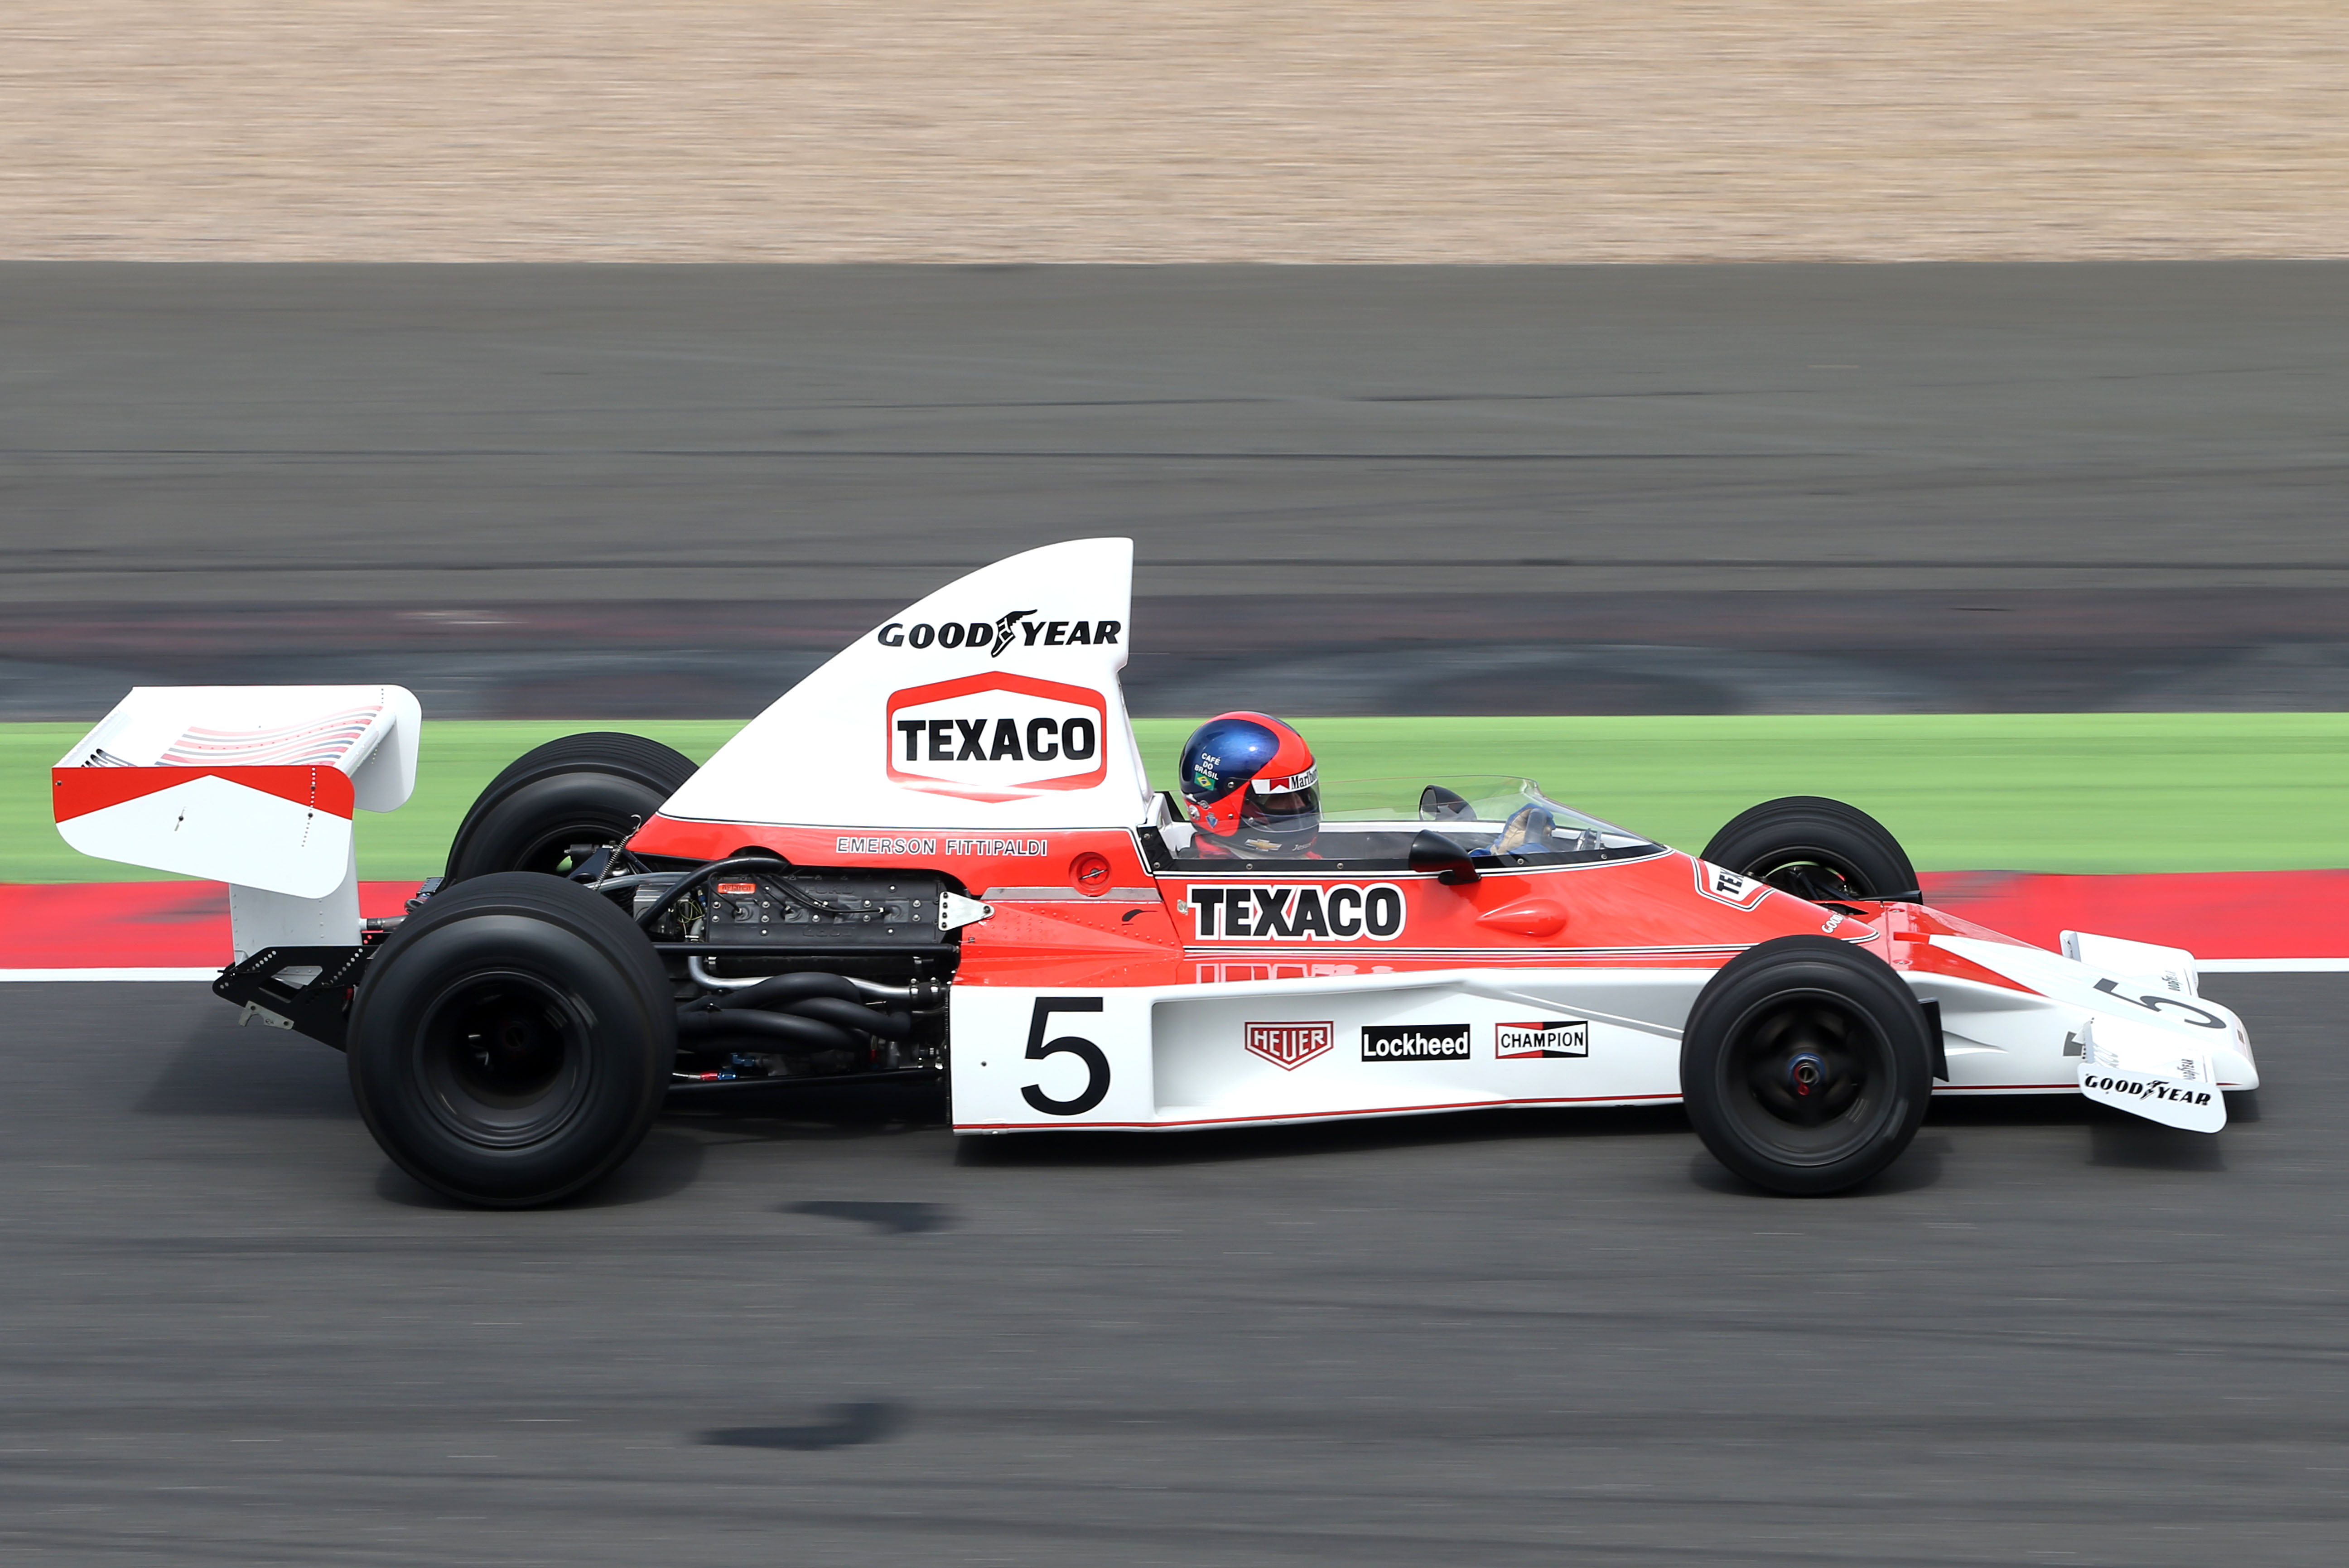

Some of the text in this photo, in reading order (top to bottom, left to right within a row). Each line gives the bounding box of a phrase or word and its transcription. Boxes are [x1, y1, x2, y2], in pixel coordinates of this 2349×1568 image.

[897, 717, 1095, 761] TEXACO
[1194, 764, 1219, 780] BRASIL
[1201, 753, 1220, 766] CAFÉ
[1203, 761, 1213, 770] DO
[835, 836, 1048, 857] EMERSON FITTIPALDI
[1191, 887, 1402, 937] TEXACO
[2092, 977, 2227, 1029] 5
[1254, 1029, 1325, 1061] HEUER
[1364, 1032, 1468, 1057] Lockheed
[1500, 1032, 1583, 1048] CHAMPION
[1021, 996, 1110, 1116] 5
